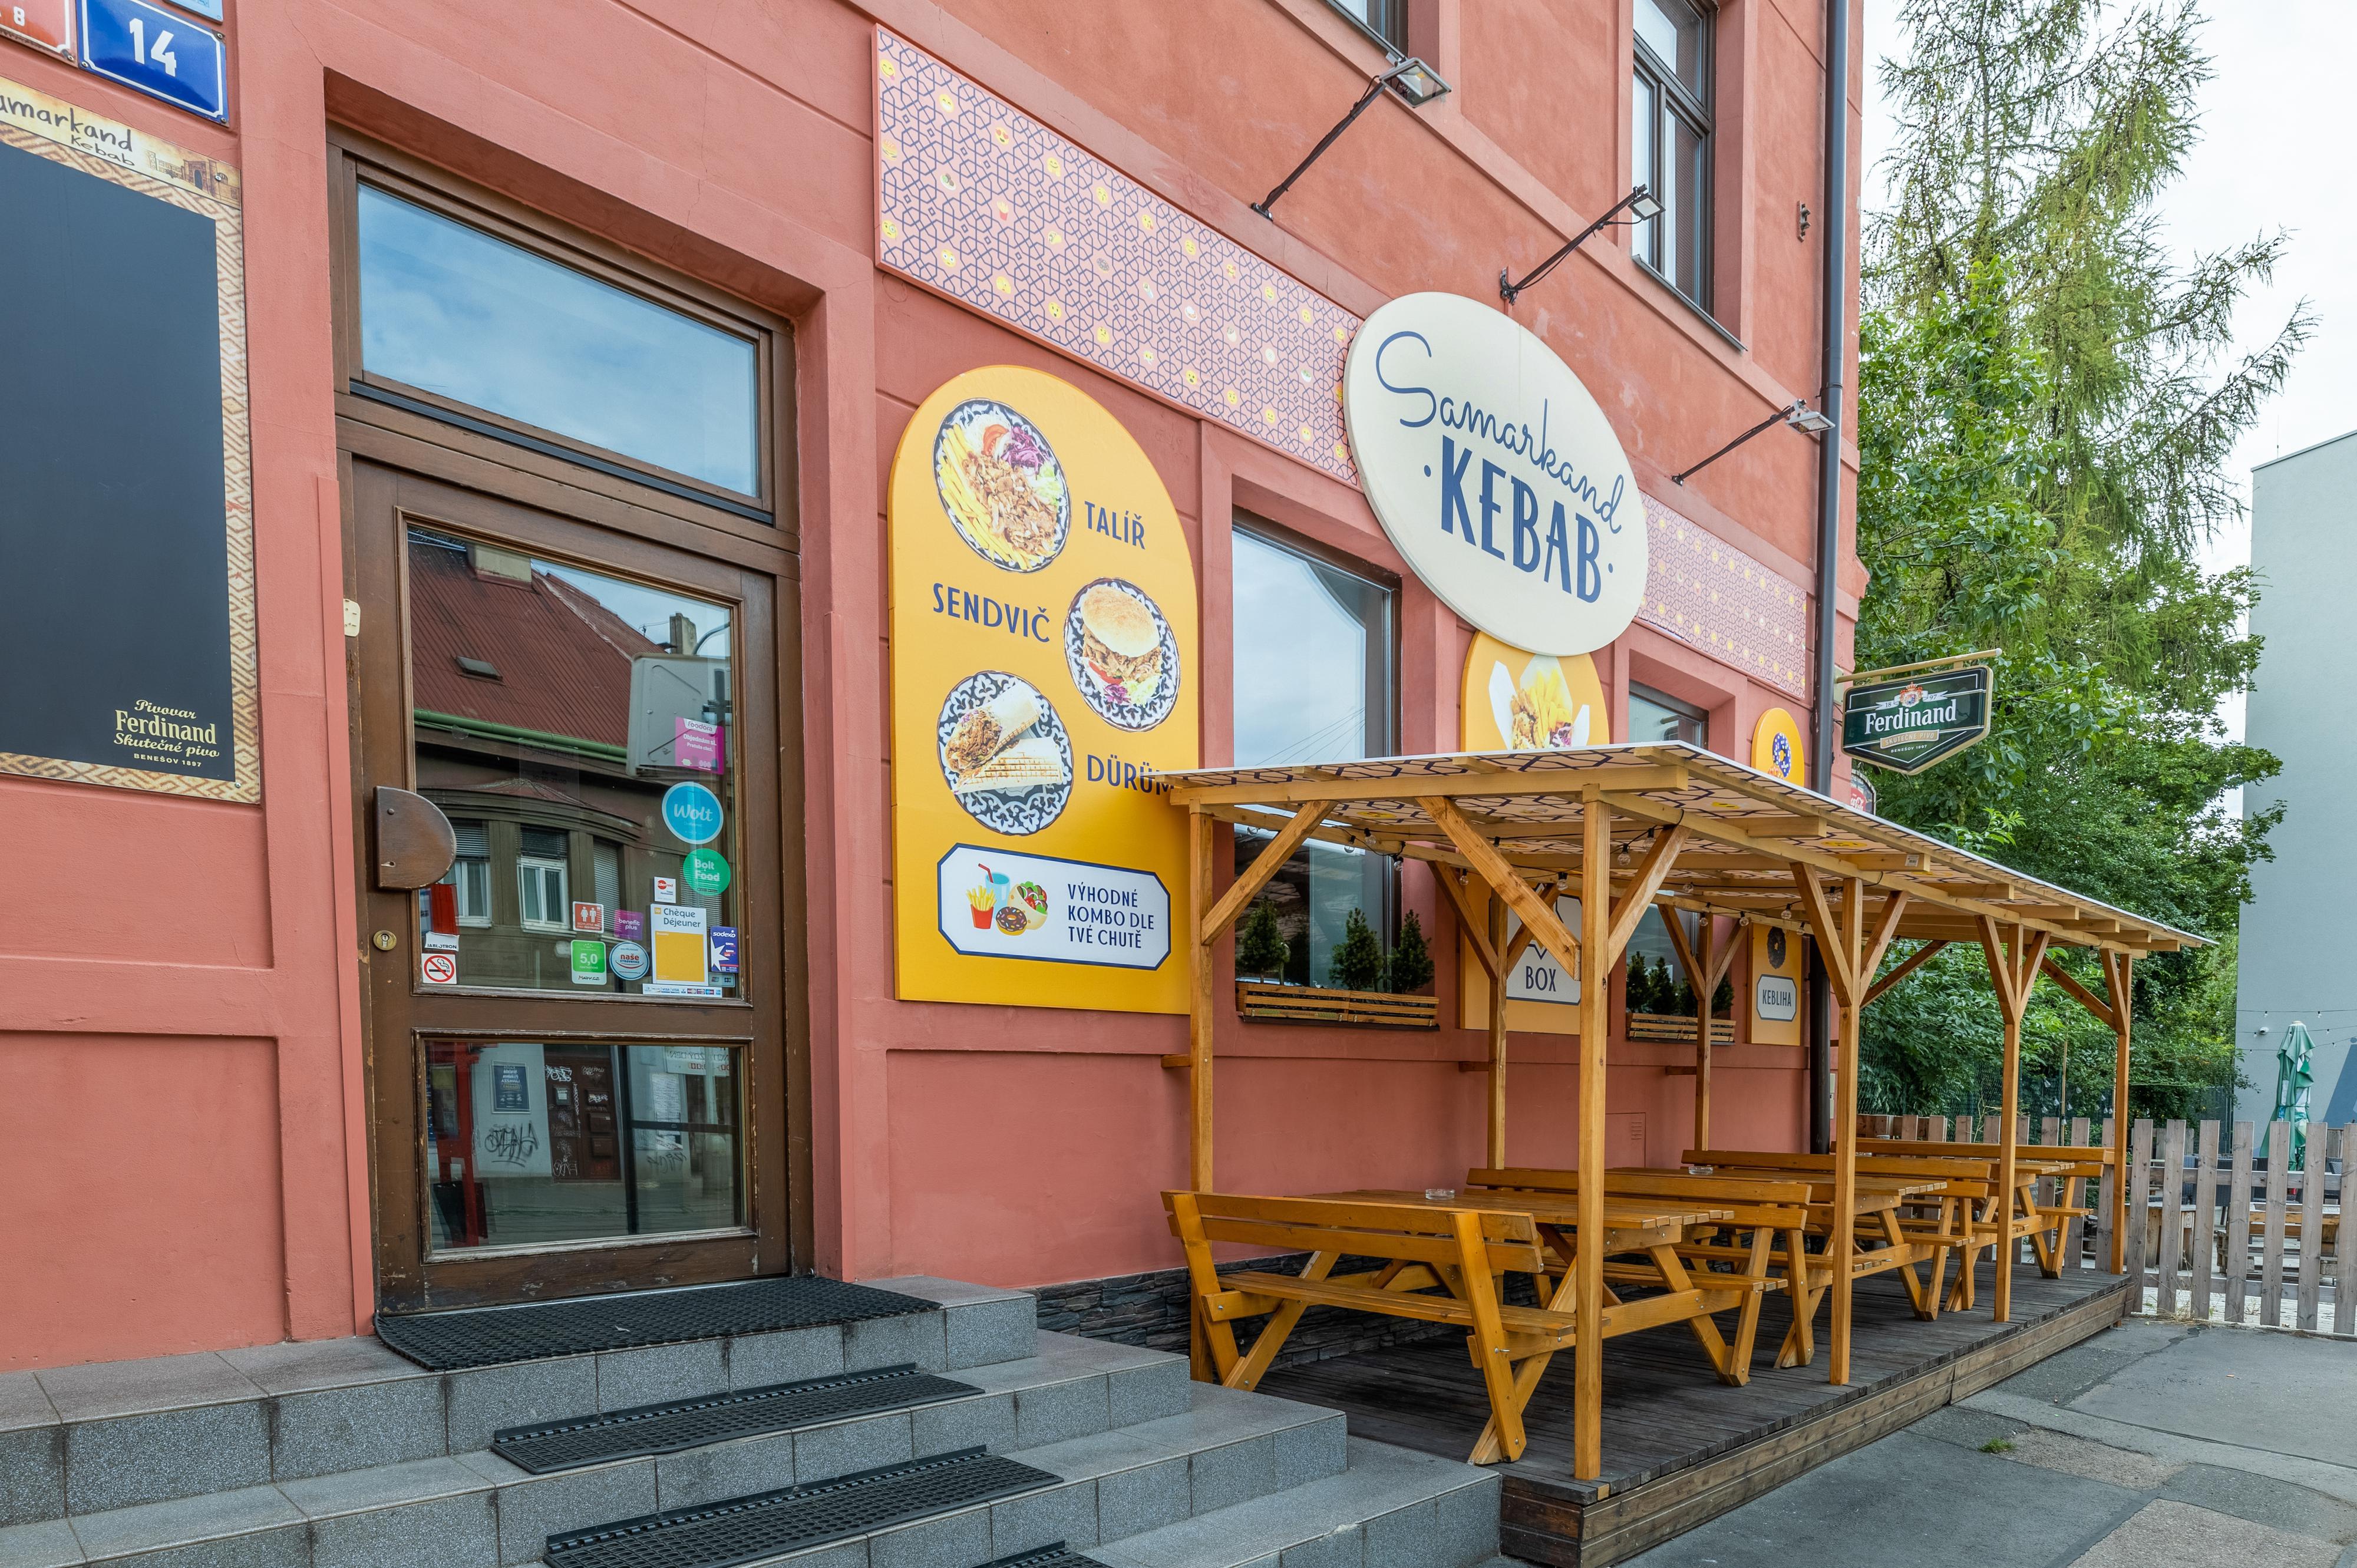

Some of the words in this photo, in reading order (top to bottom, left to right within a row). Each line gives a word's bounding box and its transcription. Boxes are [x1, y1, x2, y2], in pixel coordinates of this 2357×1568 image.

[13, 6, 25, 27] 8
[129, 18, 177, 77] 14
[71, 134, 136, 166] Kebab
[1376, 330, 1625, 534] Samarkand
[1084, 500, 1147, 550] TALÍŘ
[1441, 434, 1602, 604] KEBAB
[933, 582, 1051, 643] SENDVIČ
[134, 699, 197, 719] Pivovar
[1864, 698, 1957, 735] Ferdinand
[114, 709, 217, 745] Ferdinand
[113, 732, 183, 752] Skutečné
[185, 745, 220, 757] pivo
[133, 753, 179, 764] BENEŠOV
[674, 803, 713, 821] Wolt
[694, 858, 715, 870] Bolt
[695, 870, 720, 882] Food
[1067, 882, 1138, 908] VÝHODNÉ
[618, 918, 641, 926] benefit
[663, 908, 696, 918] Chèque
[663, 917, 701, 928] Déjeuner
[1068, 905, 1125, 927] KOMBO
[1130, 913, 1154, 930] DLE
[712, 930, 736, 938] sodexo
[1068, 926, 1093, 944] TVÉ
[1098, 929, 1142, 949] CHUTĚ
[580, 953, 598, 966] 5,0
[1525, 966, 1557, 992] BOX
[1762, 989, 1792, 1007] KEBLIHA
